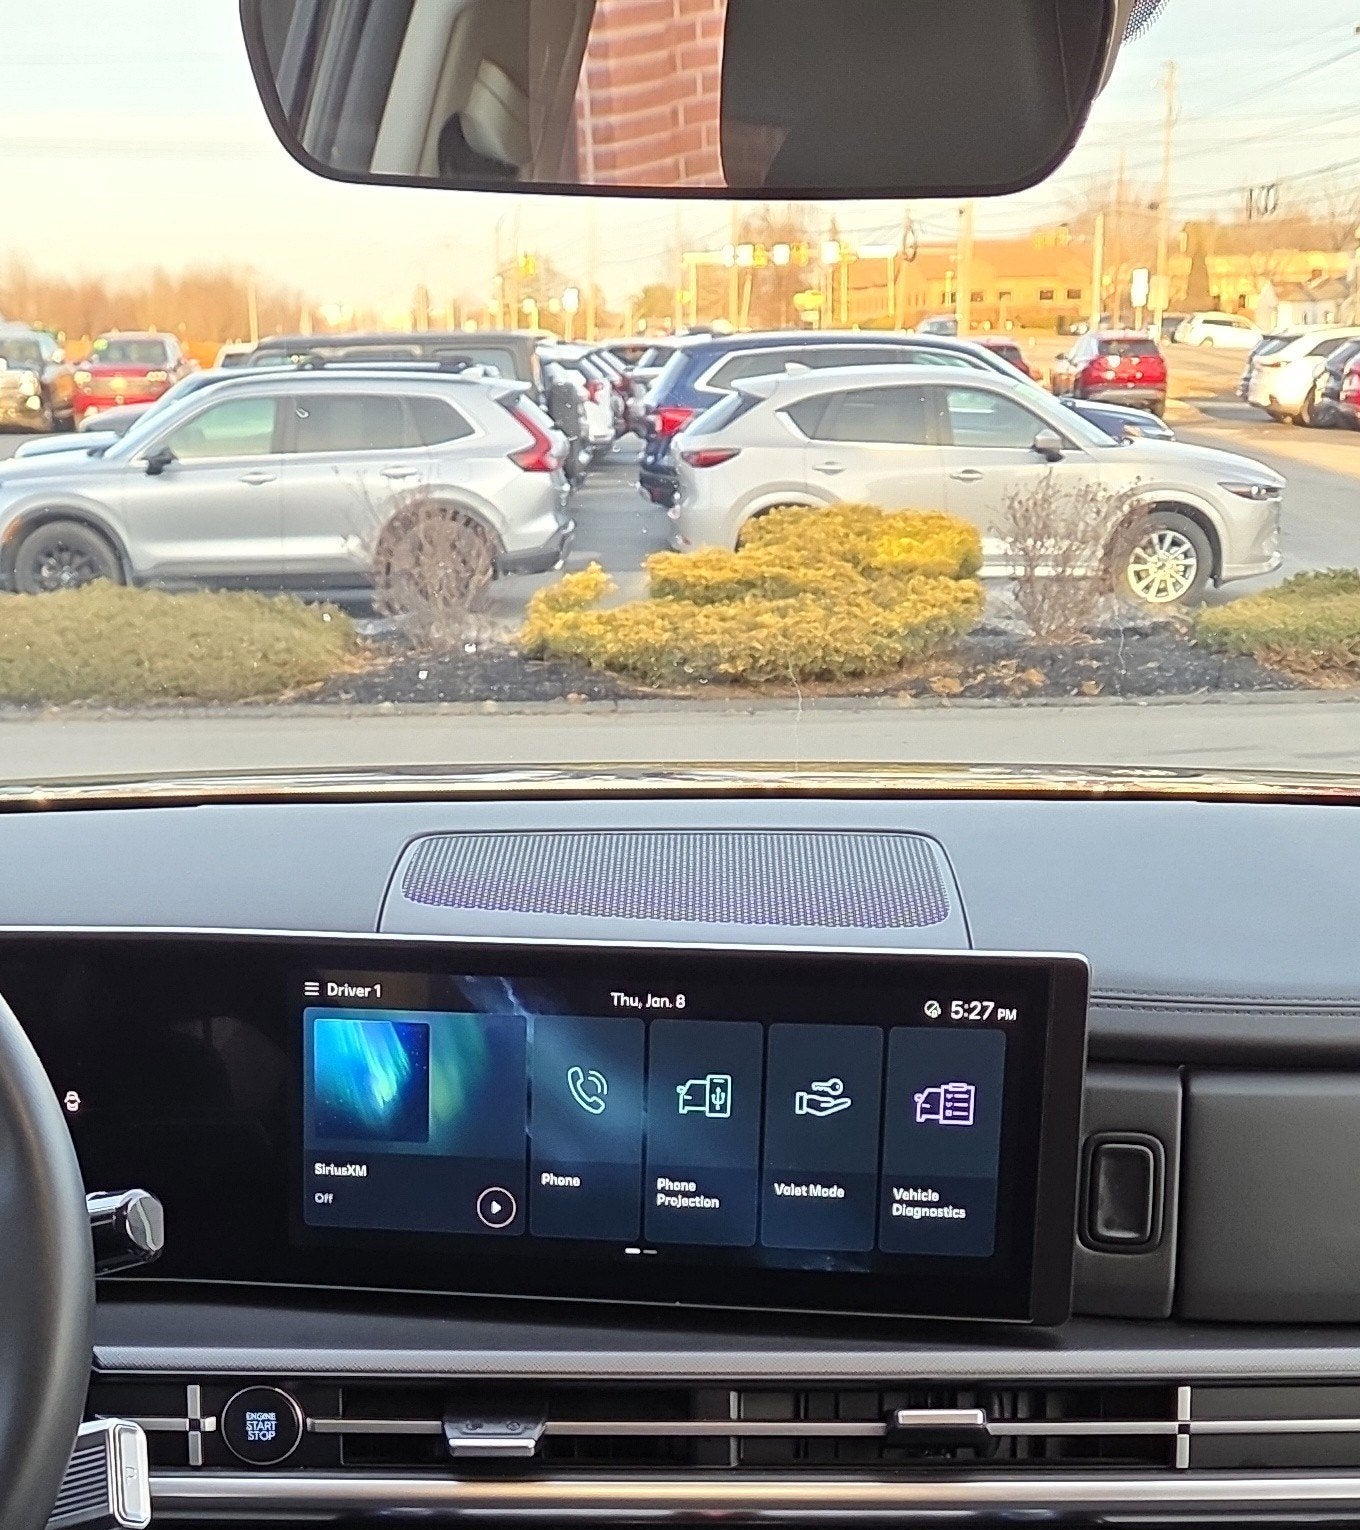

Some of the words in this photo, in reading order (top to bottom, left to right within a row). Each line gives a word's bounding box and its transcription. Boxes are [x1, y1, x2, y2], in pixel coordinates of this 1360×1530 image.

[326, 982, 372, 998] Driver
[374, 983, 382, 998] 1
[610, 991, 643, 1010] Thu,
[675, 993, 686, 1009] 8
[950, 1000, 995, 1021] 5:27
[997, 1008, 1018, 1021] PM
[314, 1162, 368, 1178] SiriusXM
[540, 1172, 581, 1188] Phone
[656, 1177, 697, 1192] Phone
[314, 1192, 334, 1204] Off
[773, 1182, 808, 1197] Valet
[808, 1184, 845, 1199] Mode
[892, 1187, 940, 1202] Vehicle
[655, 1192, 720, 1209] Projection
[891, 1202, 967, 1219] Diagnostics
[245, 1411, 277, 1420] ENGINE
[245, 1420, 278, 1430] START
[247, 1430, 277, 1441] STOP
